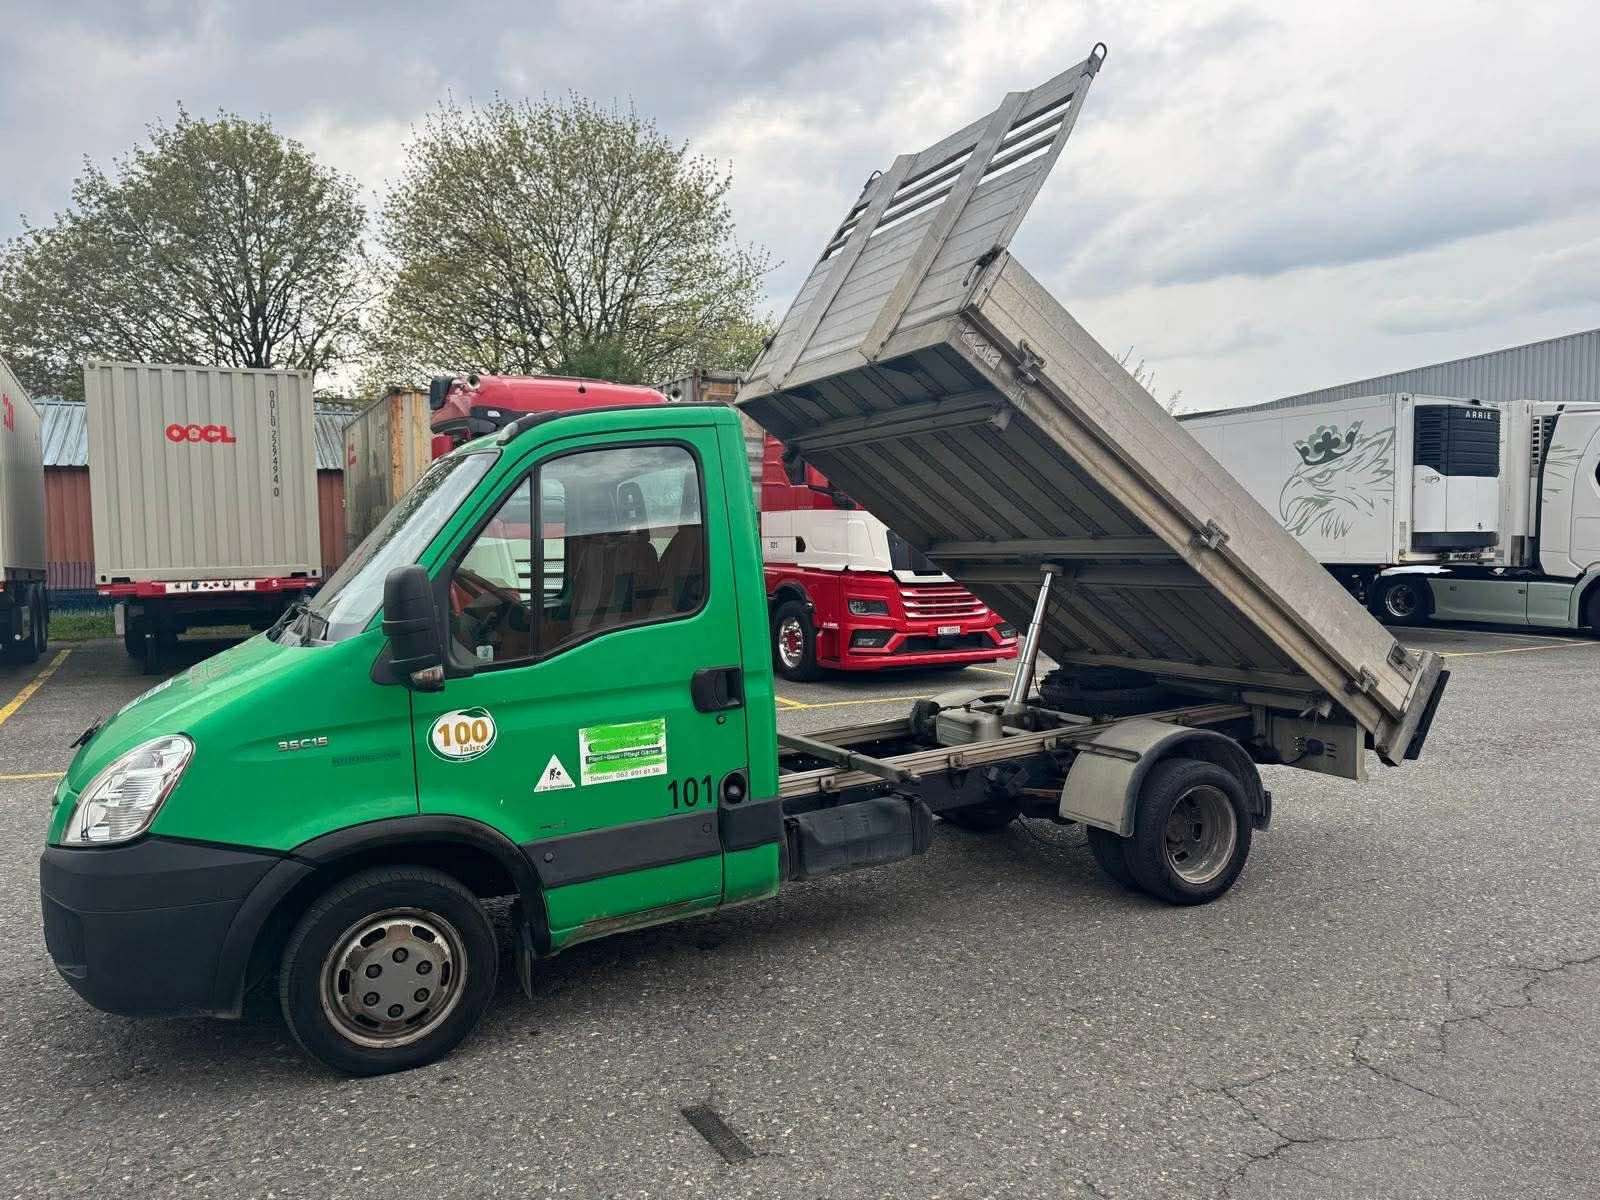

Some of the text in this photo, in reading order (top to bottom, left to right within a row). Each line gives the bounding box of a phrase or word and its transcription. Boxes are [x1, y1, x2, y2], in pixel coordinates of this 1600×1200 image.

[166, 424, 236, 443] OOCL
[278, 736, 328, 751] 35C15
[437, 719, 488, 747] 100
[667, 775, 712, 809] 101
